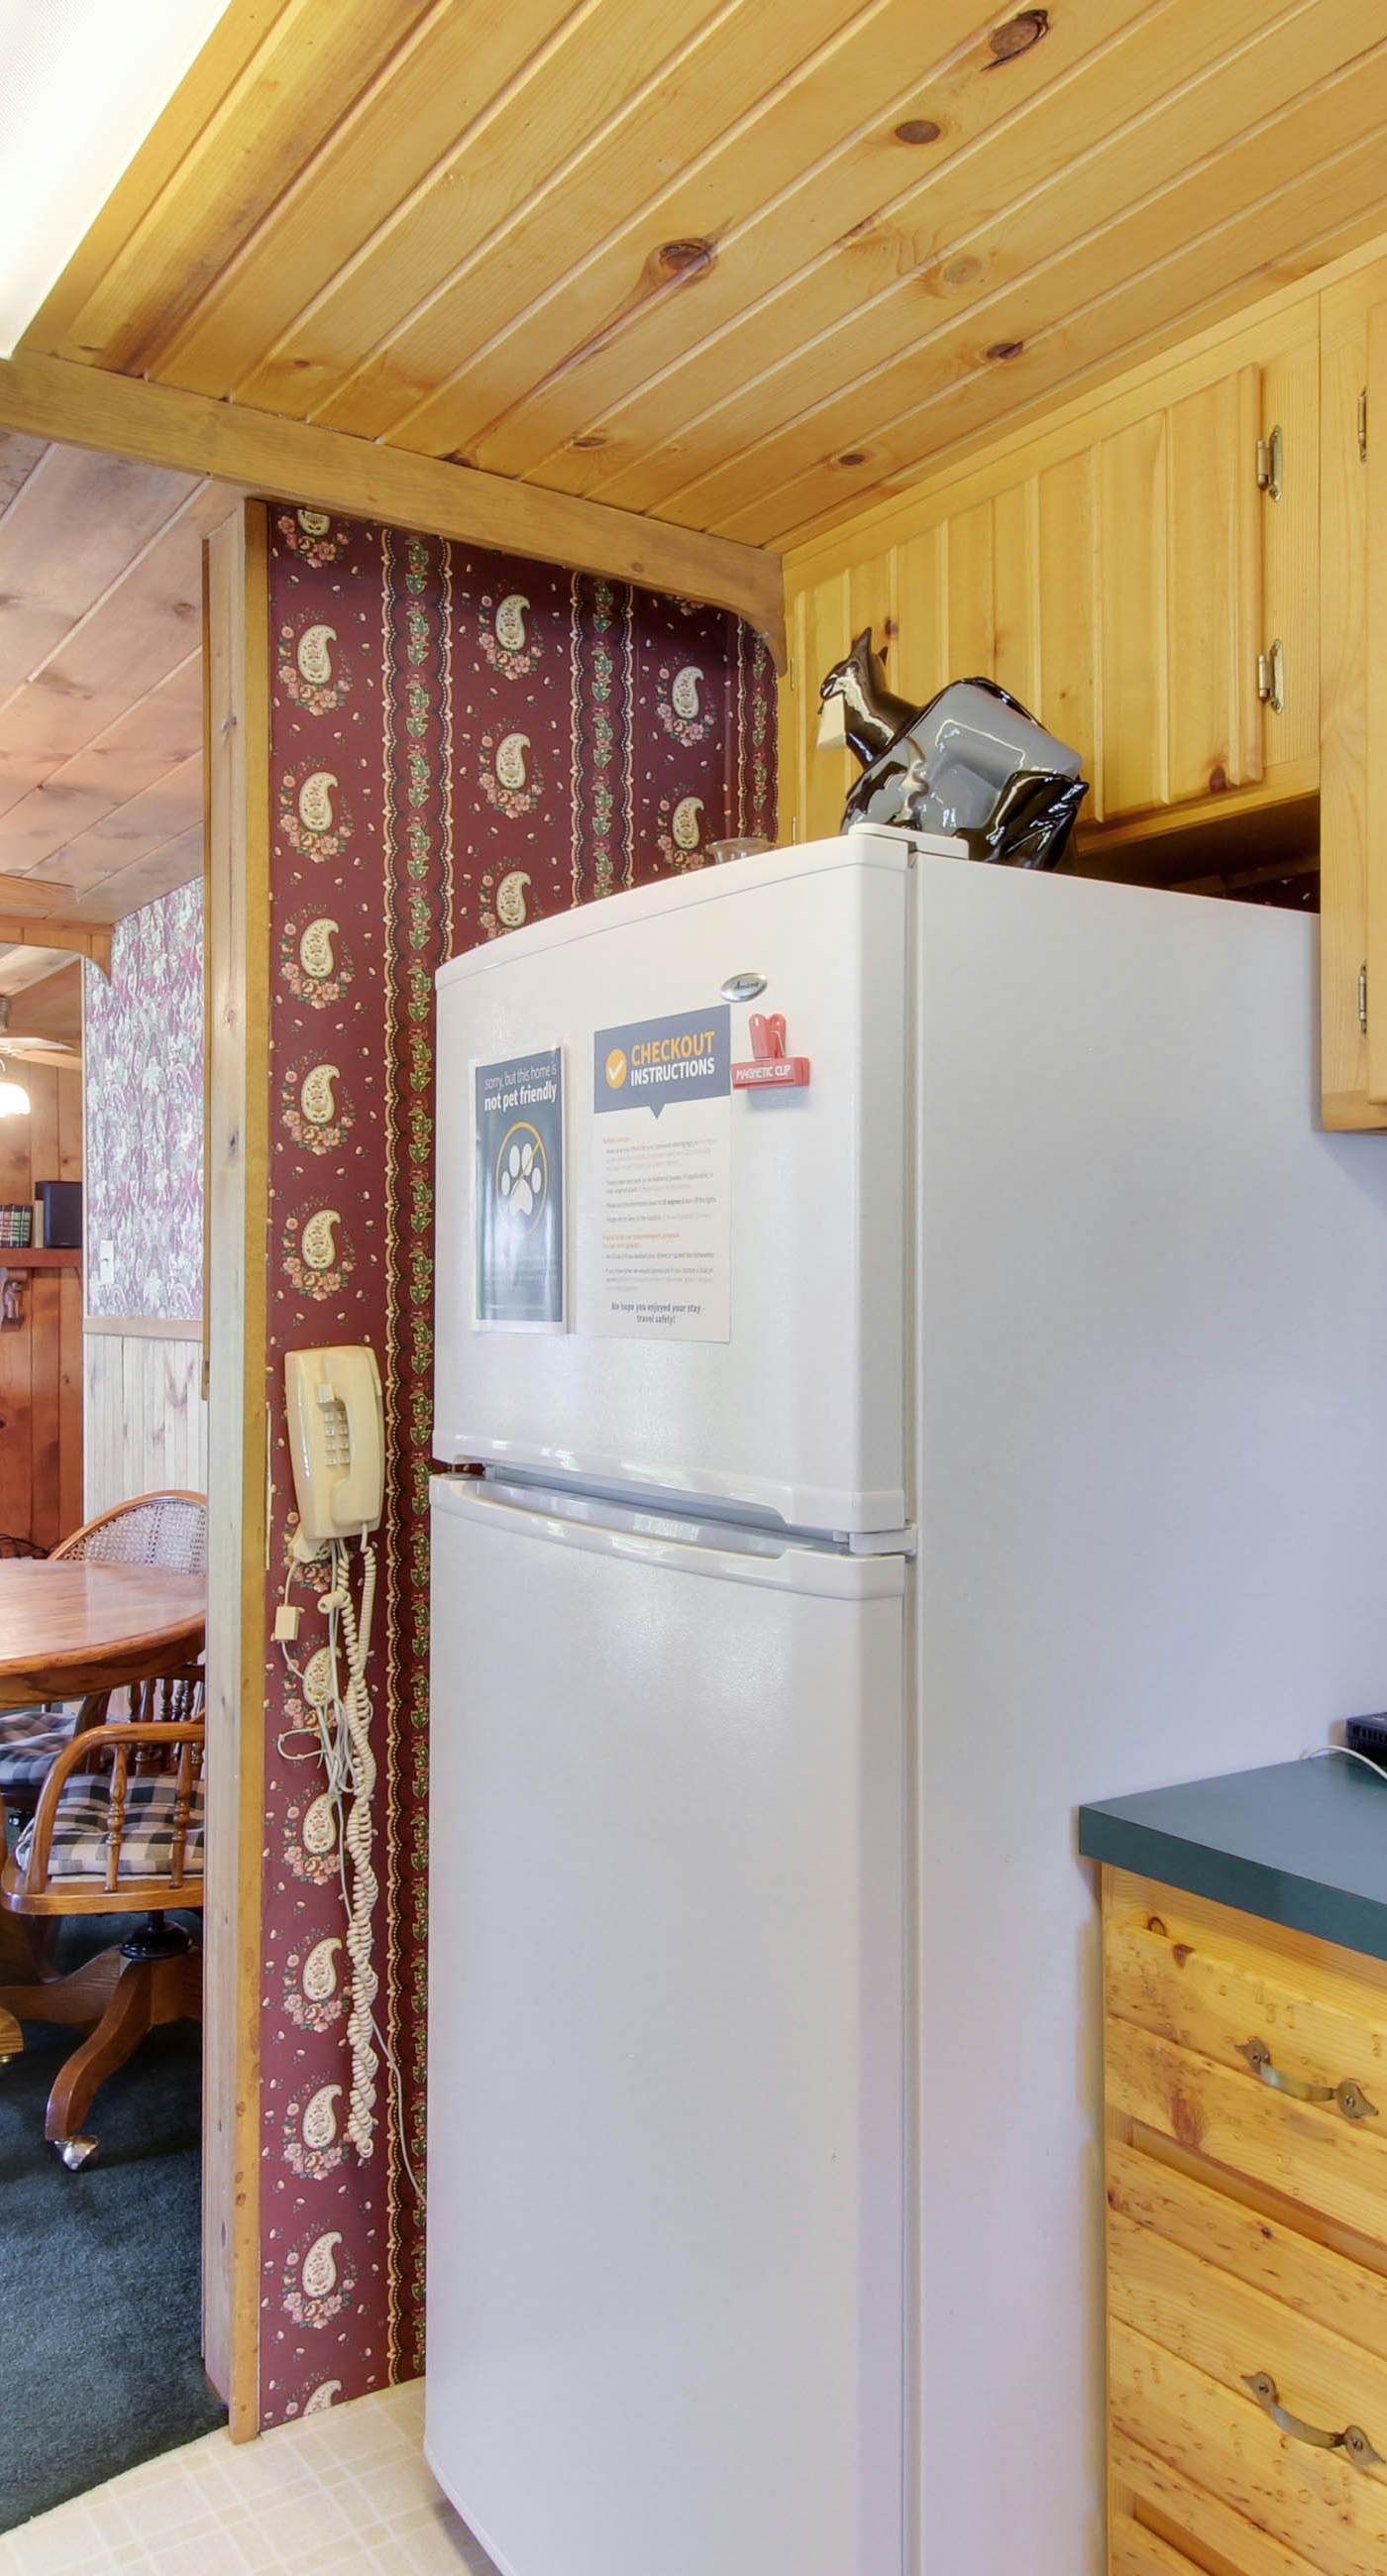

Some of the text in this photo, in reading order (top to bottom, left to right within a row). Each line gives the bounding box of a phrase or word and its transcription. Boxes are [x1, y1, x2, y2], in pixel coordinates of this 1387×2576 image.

[631, 1030, 714, 1066] CHECKOUT
[504, 1070, 516, 1086] but
[516, 1067, 530, 1082] this
[530, 1065, 551, 1079] home
[551, 1062, 557, 1075] is
[630, 1057, 715, 1086] INSTRUCTIONS
[736, 1066, 773, 1081] MAGNETIC
[484, 1081, 557, 1113] not pet friendly
[620, 1302, 634, 1313] hope
[636, 1304, 646, 1313] you
[647, 1302, 671, 1314] enjoyed
[672, 1304, 686, 1314] your
[687, 1304, 701, 1315] stay
[636, 1315, 654, 1325] travel
